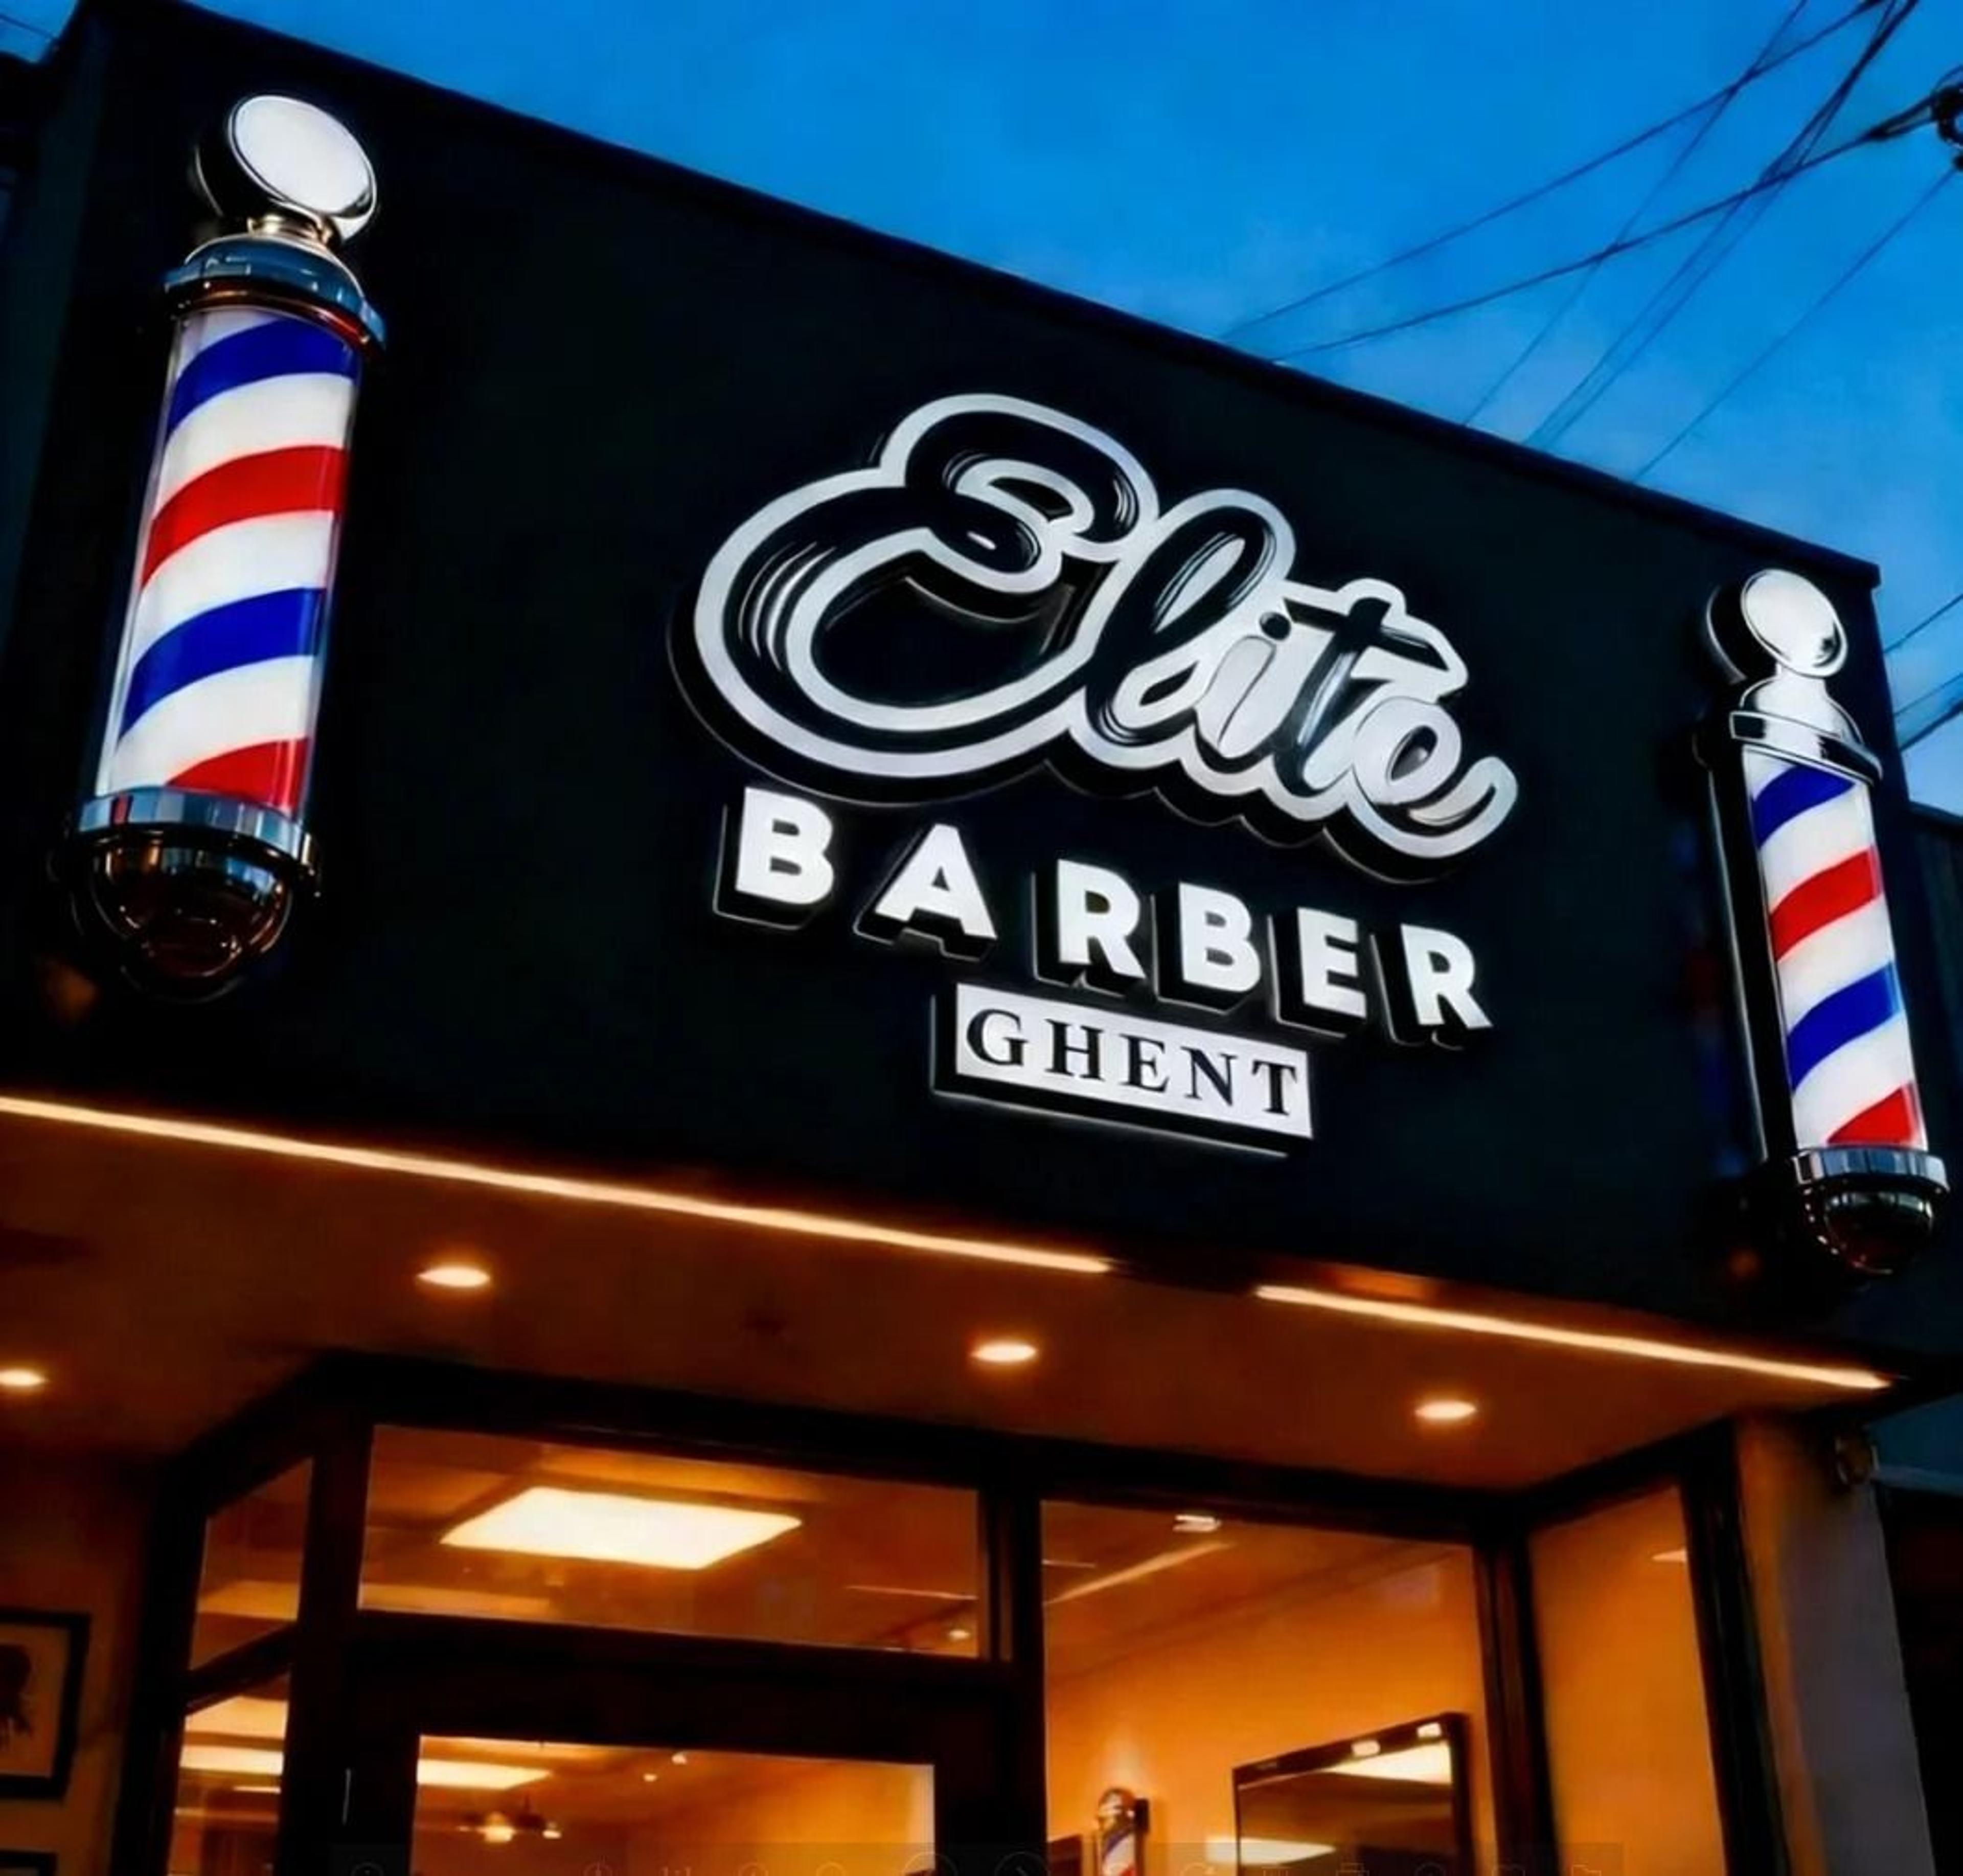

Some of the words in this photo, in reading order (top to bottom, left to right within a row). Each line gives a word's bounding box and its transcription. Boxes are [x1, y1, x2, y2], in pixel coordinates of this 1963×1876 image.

[694, 392, 1519, 858] Elite
[735, 787, 1493, 1030] BARBER
[966, 1007, 1298, 1118] GHENT
